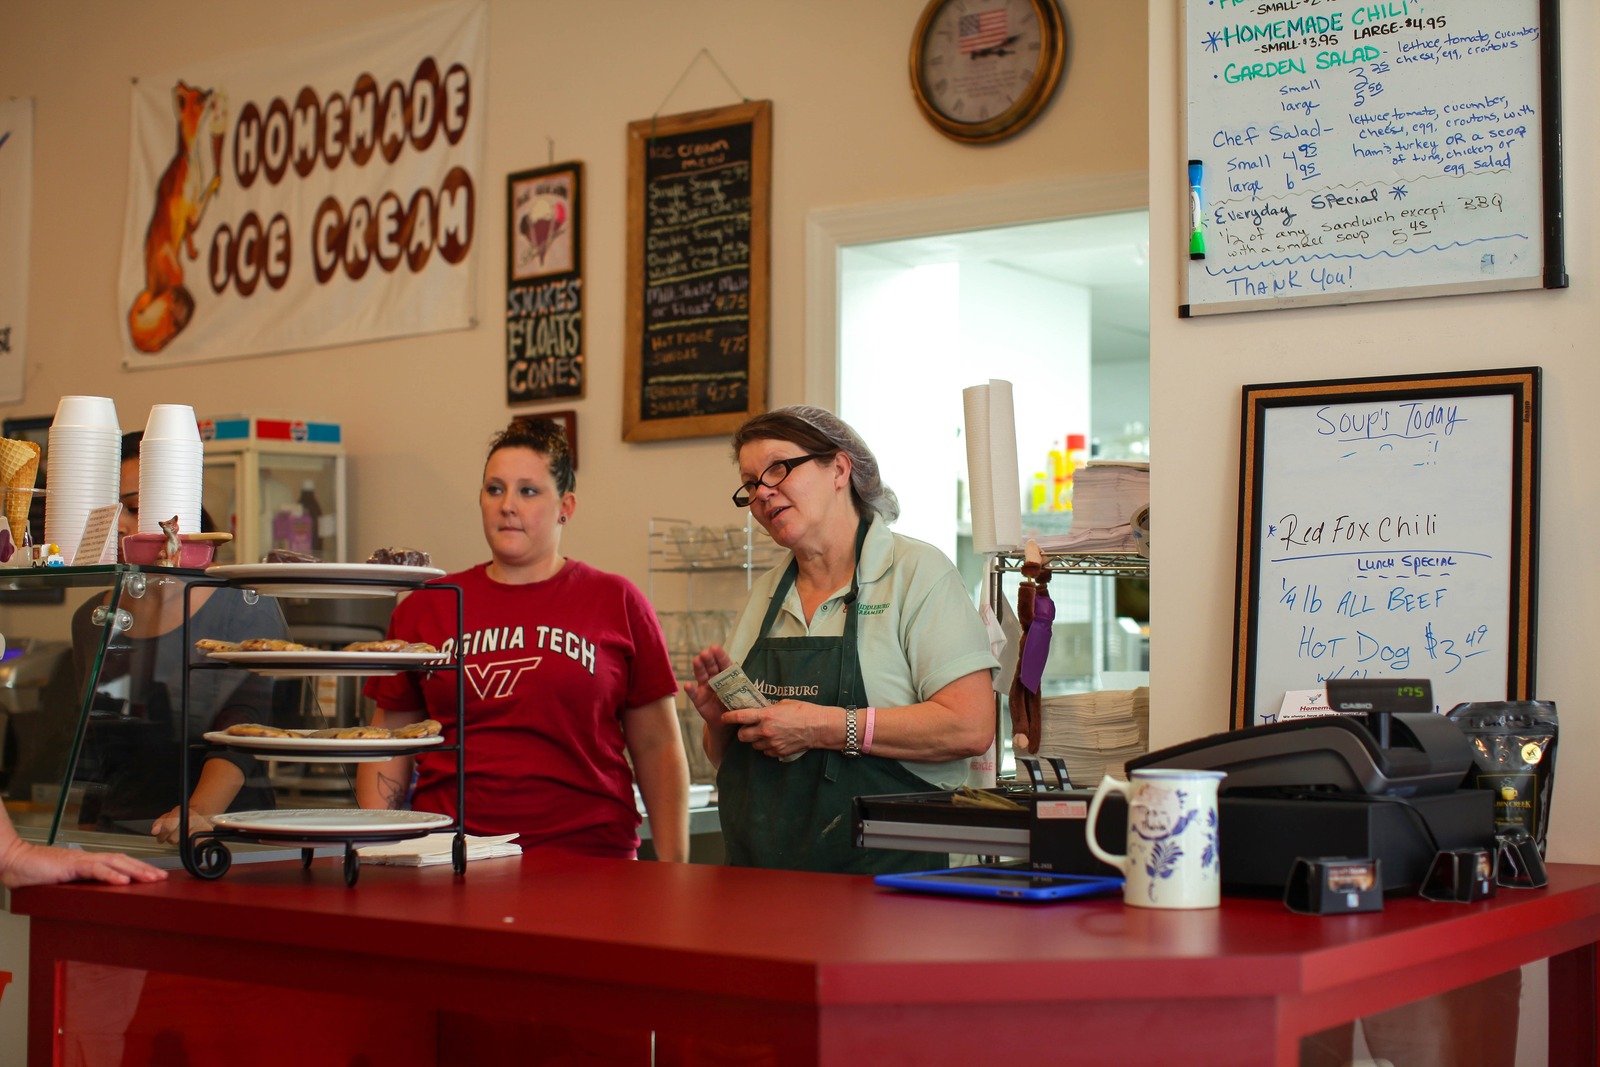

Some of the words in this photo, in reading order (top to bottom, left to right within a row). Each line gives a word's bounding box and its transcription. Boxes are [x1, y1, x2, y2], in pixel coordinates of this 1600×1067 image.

[1223, 12, 1344, 47] HOMEMADE
[1224, 57, 1306, 84] GARDEN
[235, 62, 469, 184] HOMEMADE
[1213, 126, 1259, 148] Chef
[1503, 104, 1535, 119] with
[1281, 101, 1320, 116] large
[1392, 154, 1406, 165] of
[1446, 144, 1493, 159] chicken
[1499, 139, 1515, 149] or
[1395, 138, 1439, 155] turkey
[1446, 133, 1466, 145] OR
[1471, 133, 1484, 141] a
[1489, 126, 1527, 138] scoop
[1228, 177, 1264, 195] large
[1474, 152, 1511, 169] salad
[1214, 203, 1297, 226] Everyday
[1250, 227, 1265, 241] of
[1275, 229, 1310, 243] any
[1321, 211, 1395, 232] sandwich
[1401, 201, 1446, 220] except
[211, 216, 290, 292] ICE
[313, 176, 471, 280] CREAM
[1227, 243, 1257, 258] with
[1277, 236, 1324, 253] small
[1336, 230, 1370, 244] soup
[508, 312, 581, 359] FLOATS
[510, 357, 582, 392] CONES
[1316, 406, 1390, 438] Soup's
[1399, 402, 1467, 436] Today
[1279, 513, 1323, 550] Red
[1332, 515, 1370, 543] Fox
[1378, 513, 1438, 542] Chili
[1401, 556, 1457, 575] SPECIAL
[1303, 584, 1322, 613] lb
[1336, 590, 1375, 618] ALL
[1387, 586, 1447, 612] BEEF
[536, 625, 596, 676] TECH
[464, 656, 543, 700] VT
